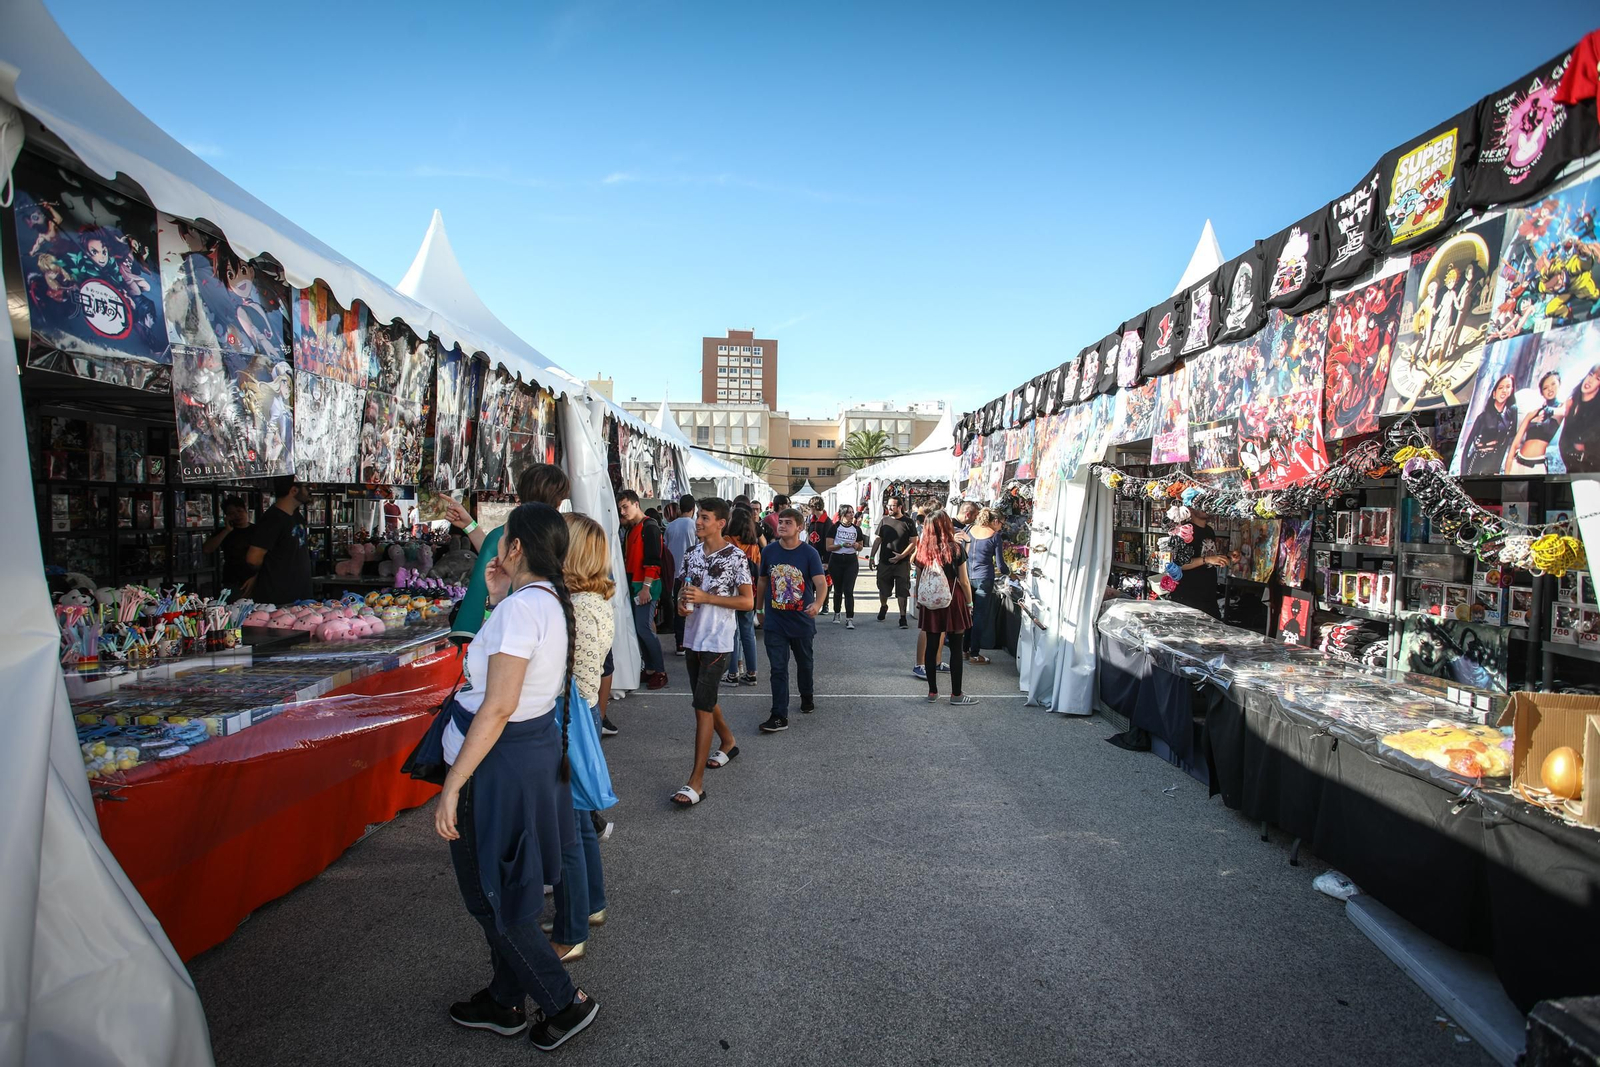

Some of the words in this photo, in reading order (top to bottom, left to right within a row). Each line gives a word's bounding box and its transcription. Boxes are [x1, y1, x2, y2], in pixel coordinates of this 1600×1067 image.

[1397, 135, 1453, 182] SUPER
[1480, 147, 1509, 159] MEKA
[1395, 171, 1420, 200] CUP
[184, 465, 236, 476] GOBLIN
[1508, 610, 1522, 618] 461
[1552, 627, 1570, 636] 788
[1580, 632, 1598, 642] 705
